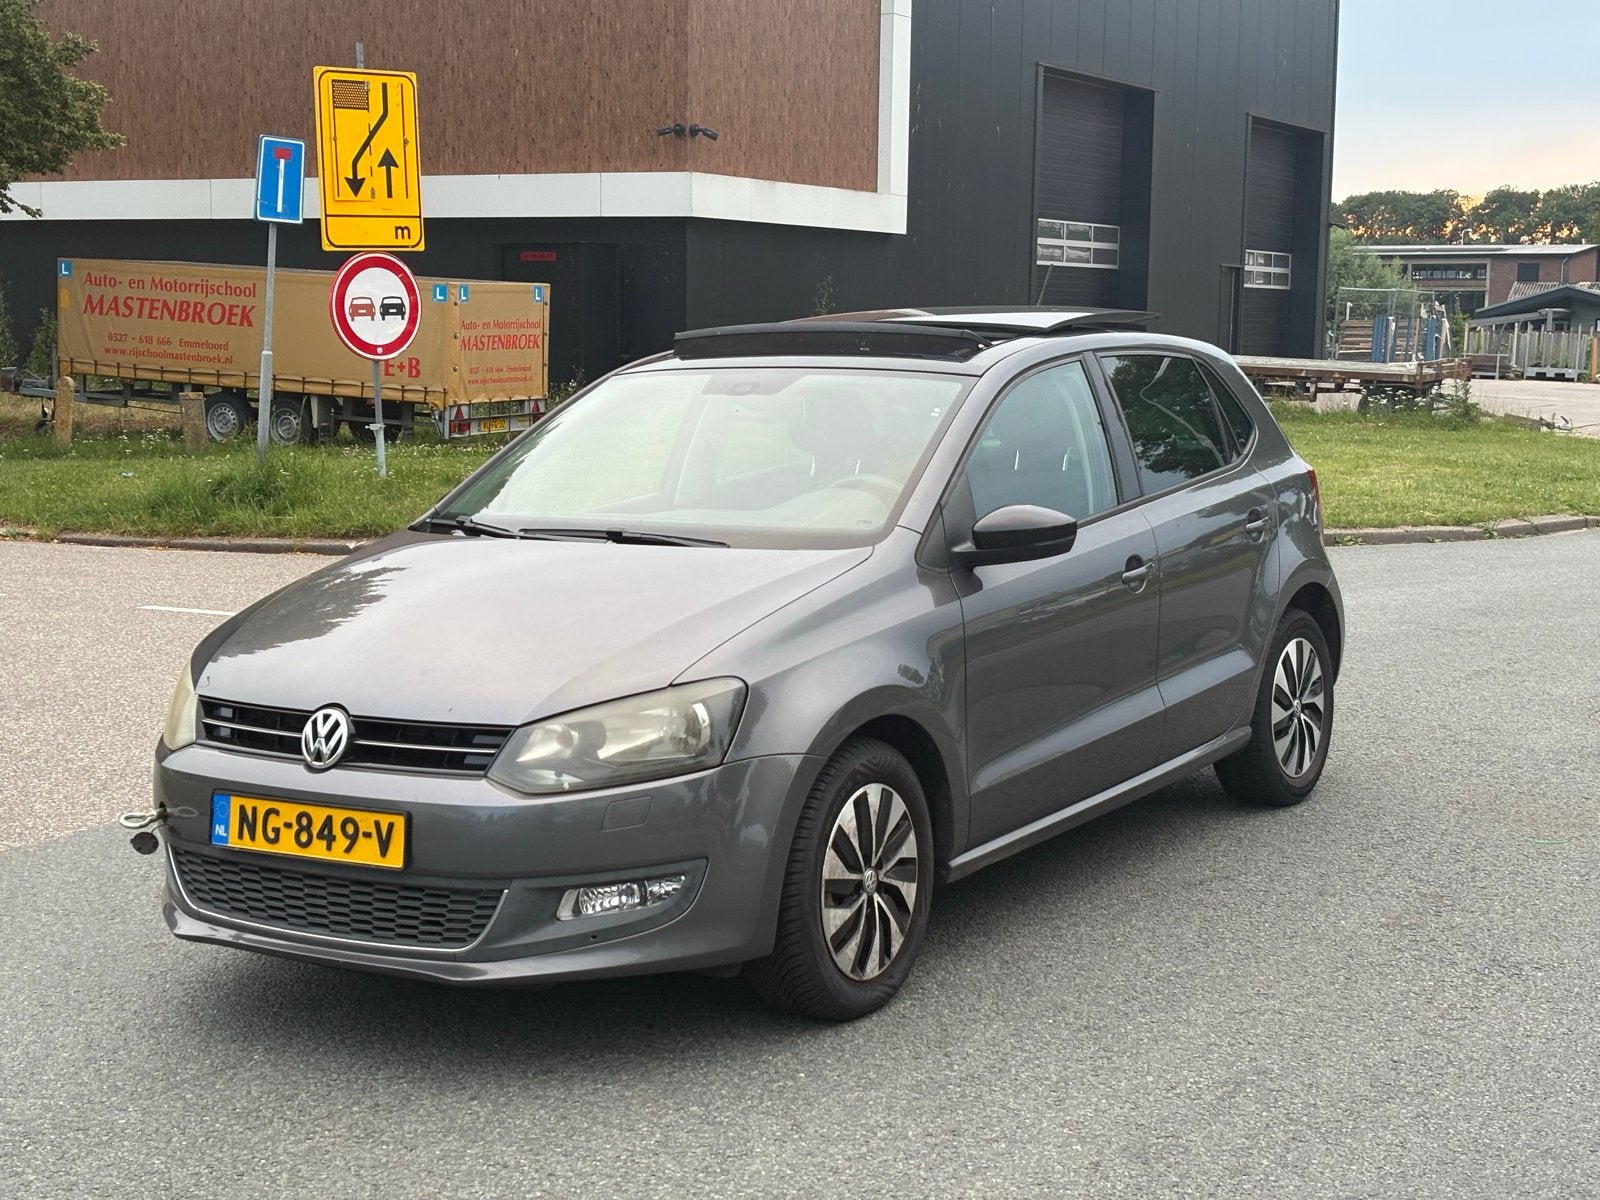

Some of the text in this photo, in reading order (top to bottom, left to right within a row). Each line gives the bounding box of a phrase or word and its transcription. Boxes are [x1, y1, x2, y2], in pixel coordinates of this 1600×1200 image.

[394, 225, 411, 240] m
[83, 272, 257, 298] Auto- en Motorrijschool
[82, 294, 256, 327] MASTENBROEK
[461, 318, 541, 331] Auto- en Motorrijschool
[107, 332, 128, 343] 0527
[138, 335, 154, 345] 618
[156, 335, 172, 346] 666
[178, 338, 229, 351] Emmeloord
[460, 333, 541, 351] MASTENBROEK
[104, 346, 233, 365] www.rijschoolmastenbroek.nl
[214, 823, 228, 837] NL
[237, 804, 395, 858] NG-849-V
